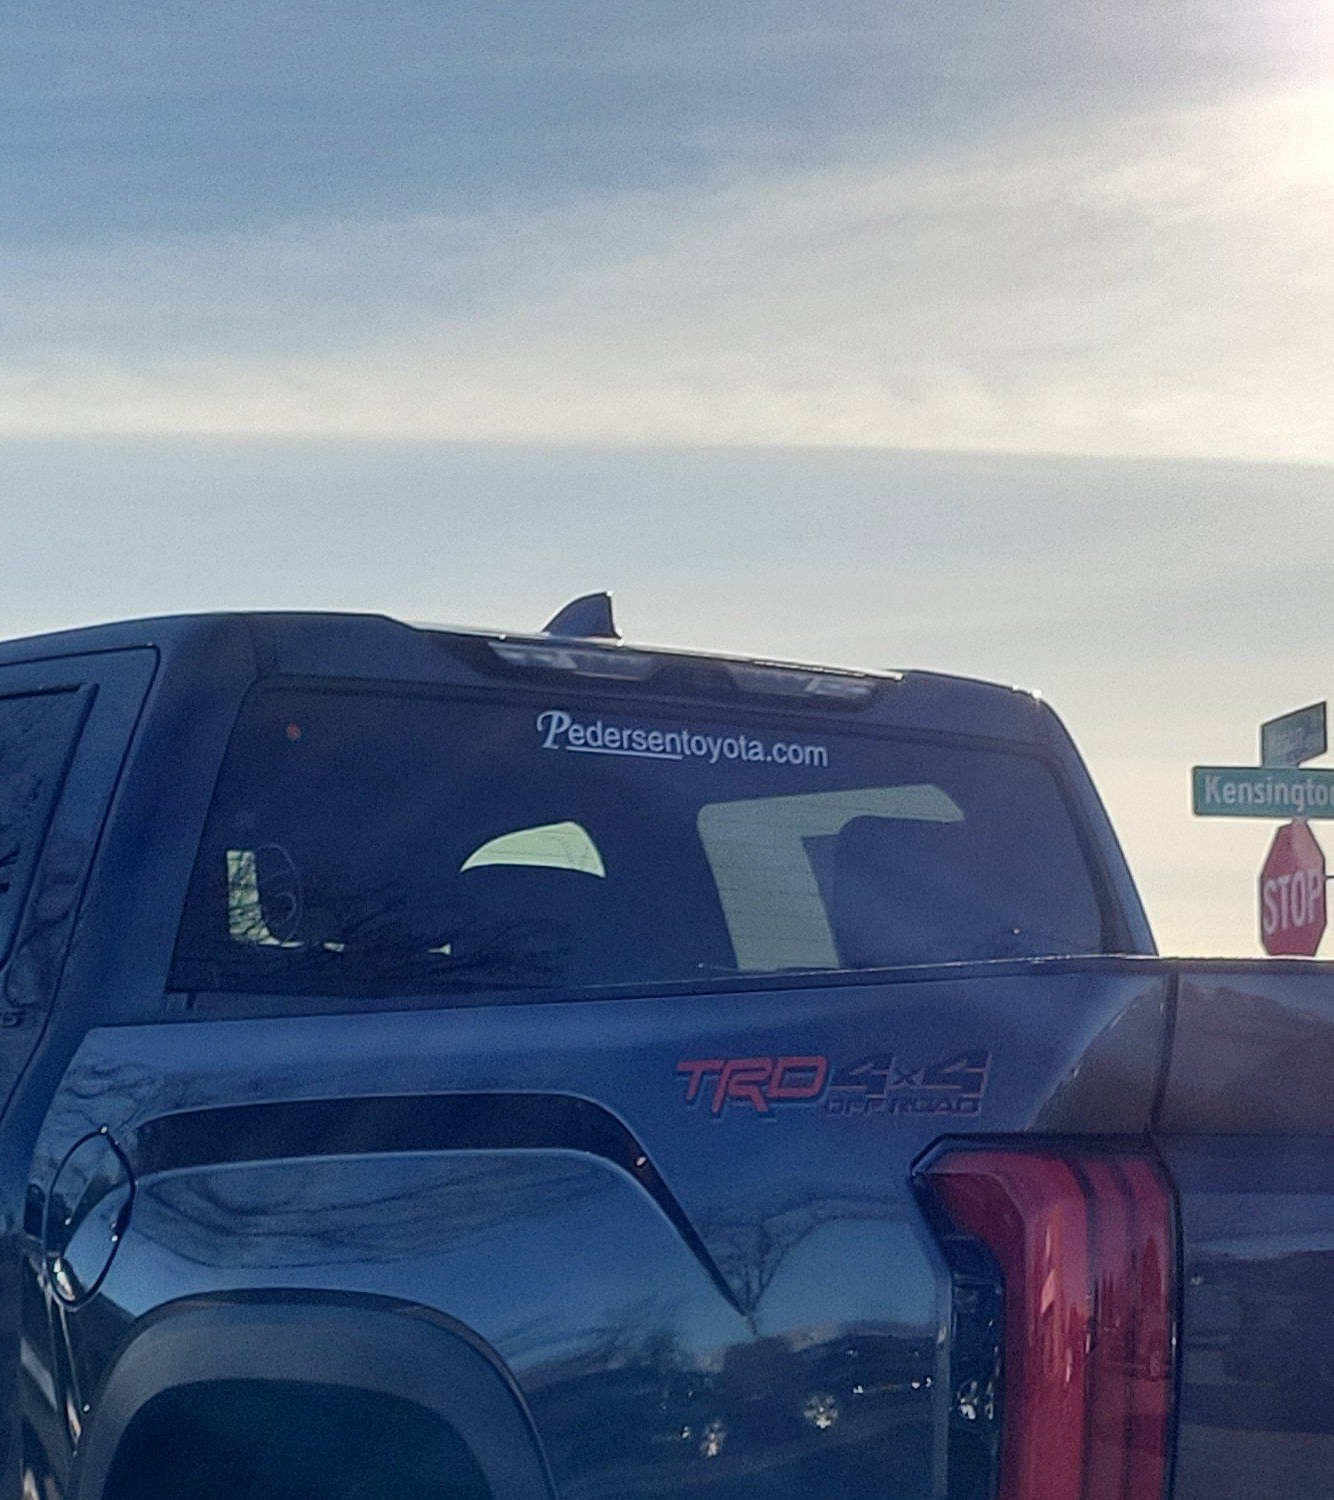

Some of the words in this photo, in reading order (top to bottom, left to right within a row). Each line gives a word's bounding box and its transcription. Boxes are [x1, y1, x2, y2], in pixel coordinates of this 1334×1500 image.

[536, 709, 829, 767] Pedersentoyota.com
[1263, 869, 1323, 934] STOP
[676, 1056, 828, 1114] TRD
